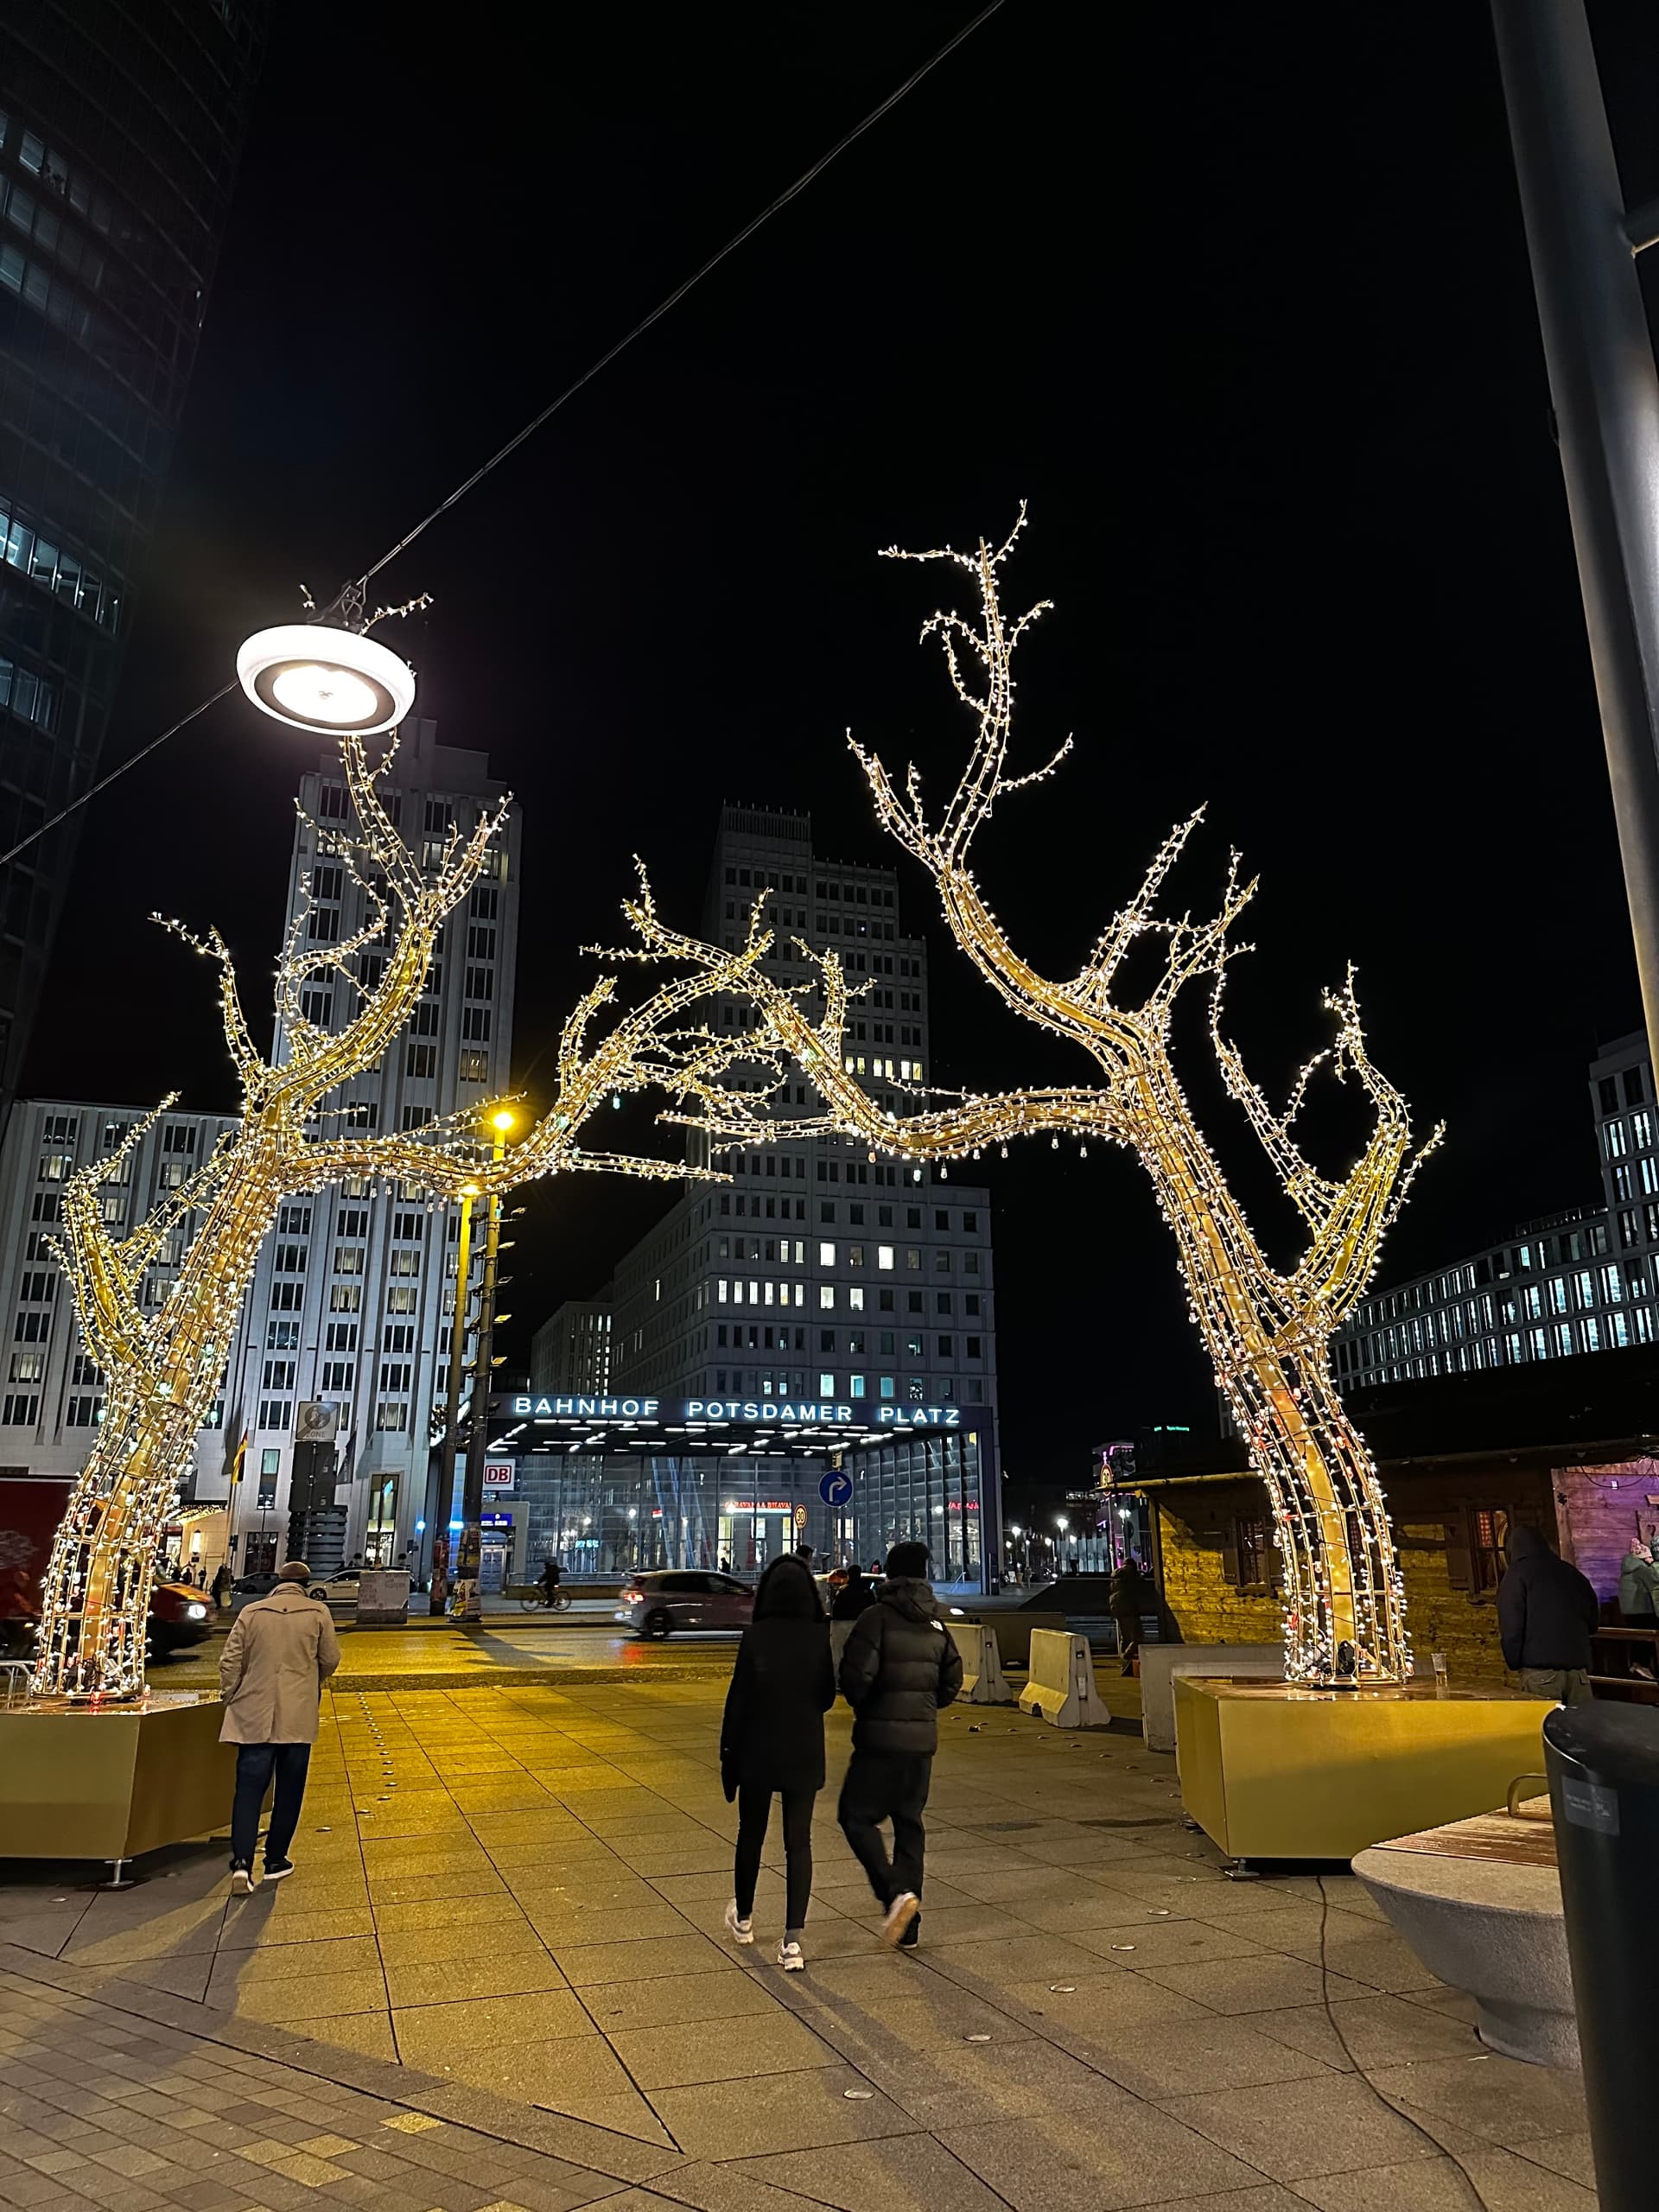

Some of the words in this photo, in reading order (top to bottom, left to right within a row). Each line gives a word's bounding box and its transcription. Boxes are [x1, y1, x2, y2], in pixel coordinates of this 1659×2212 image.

[514, 1396, 660, 1416] BAHNHOF
[687, 1401, 852, 1421] POTSDAMER
[880, 1406, 961, 1424] PLATZ
[487, 1468, 509, 1481] DB
[797, 1511, 804, 1522] 30
